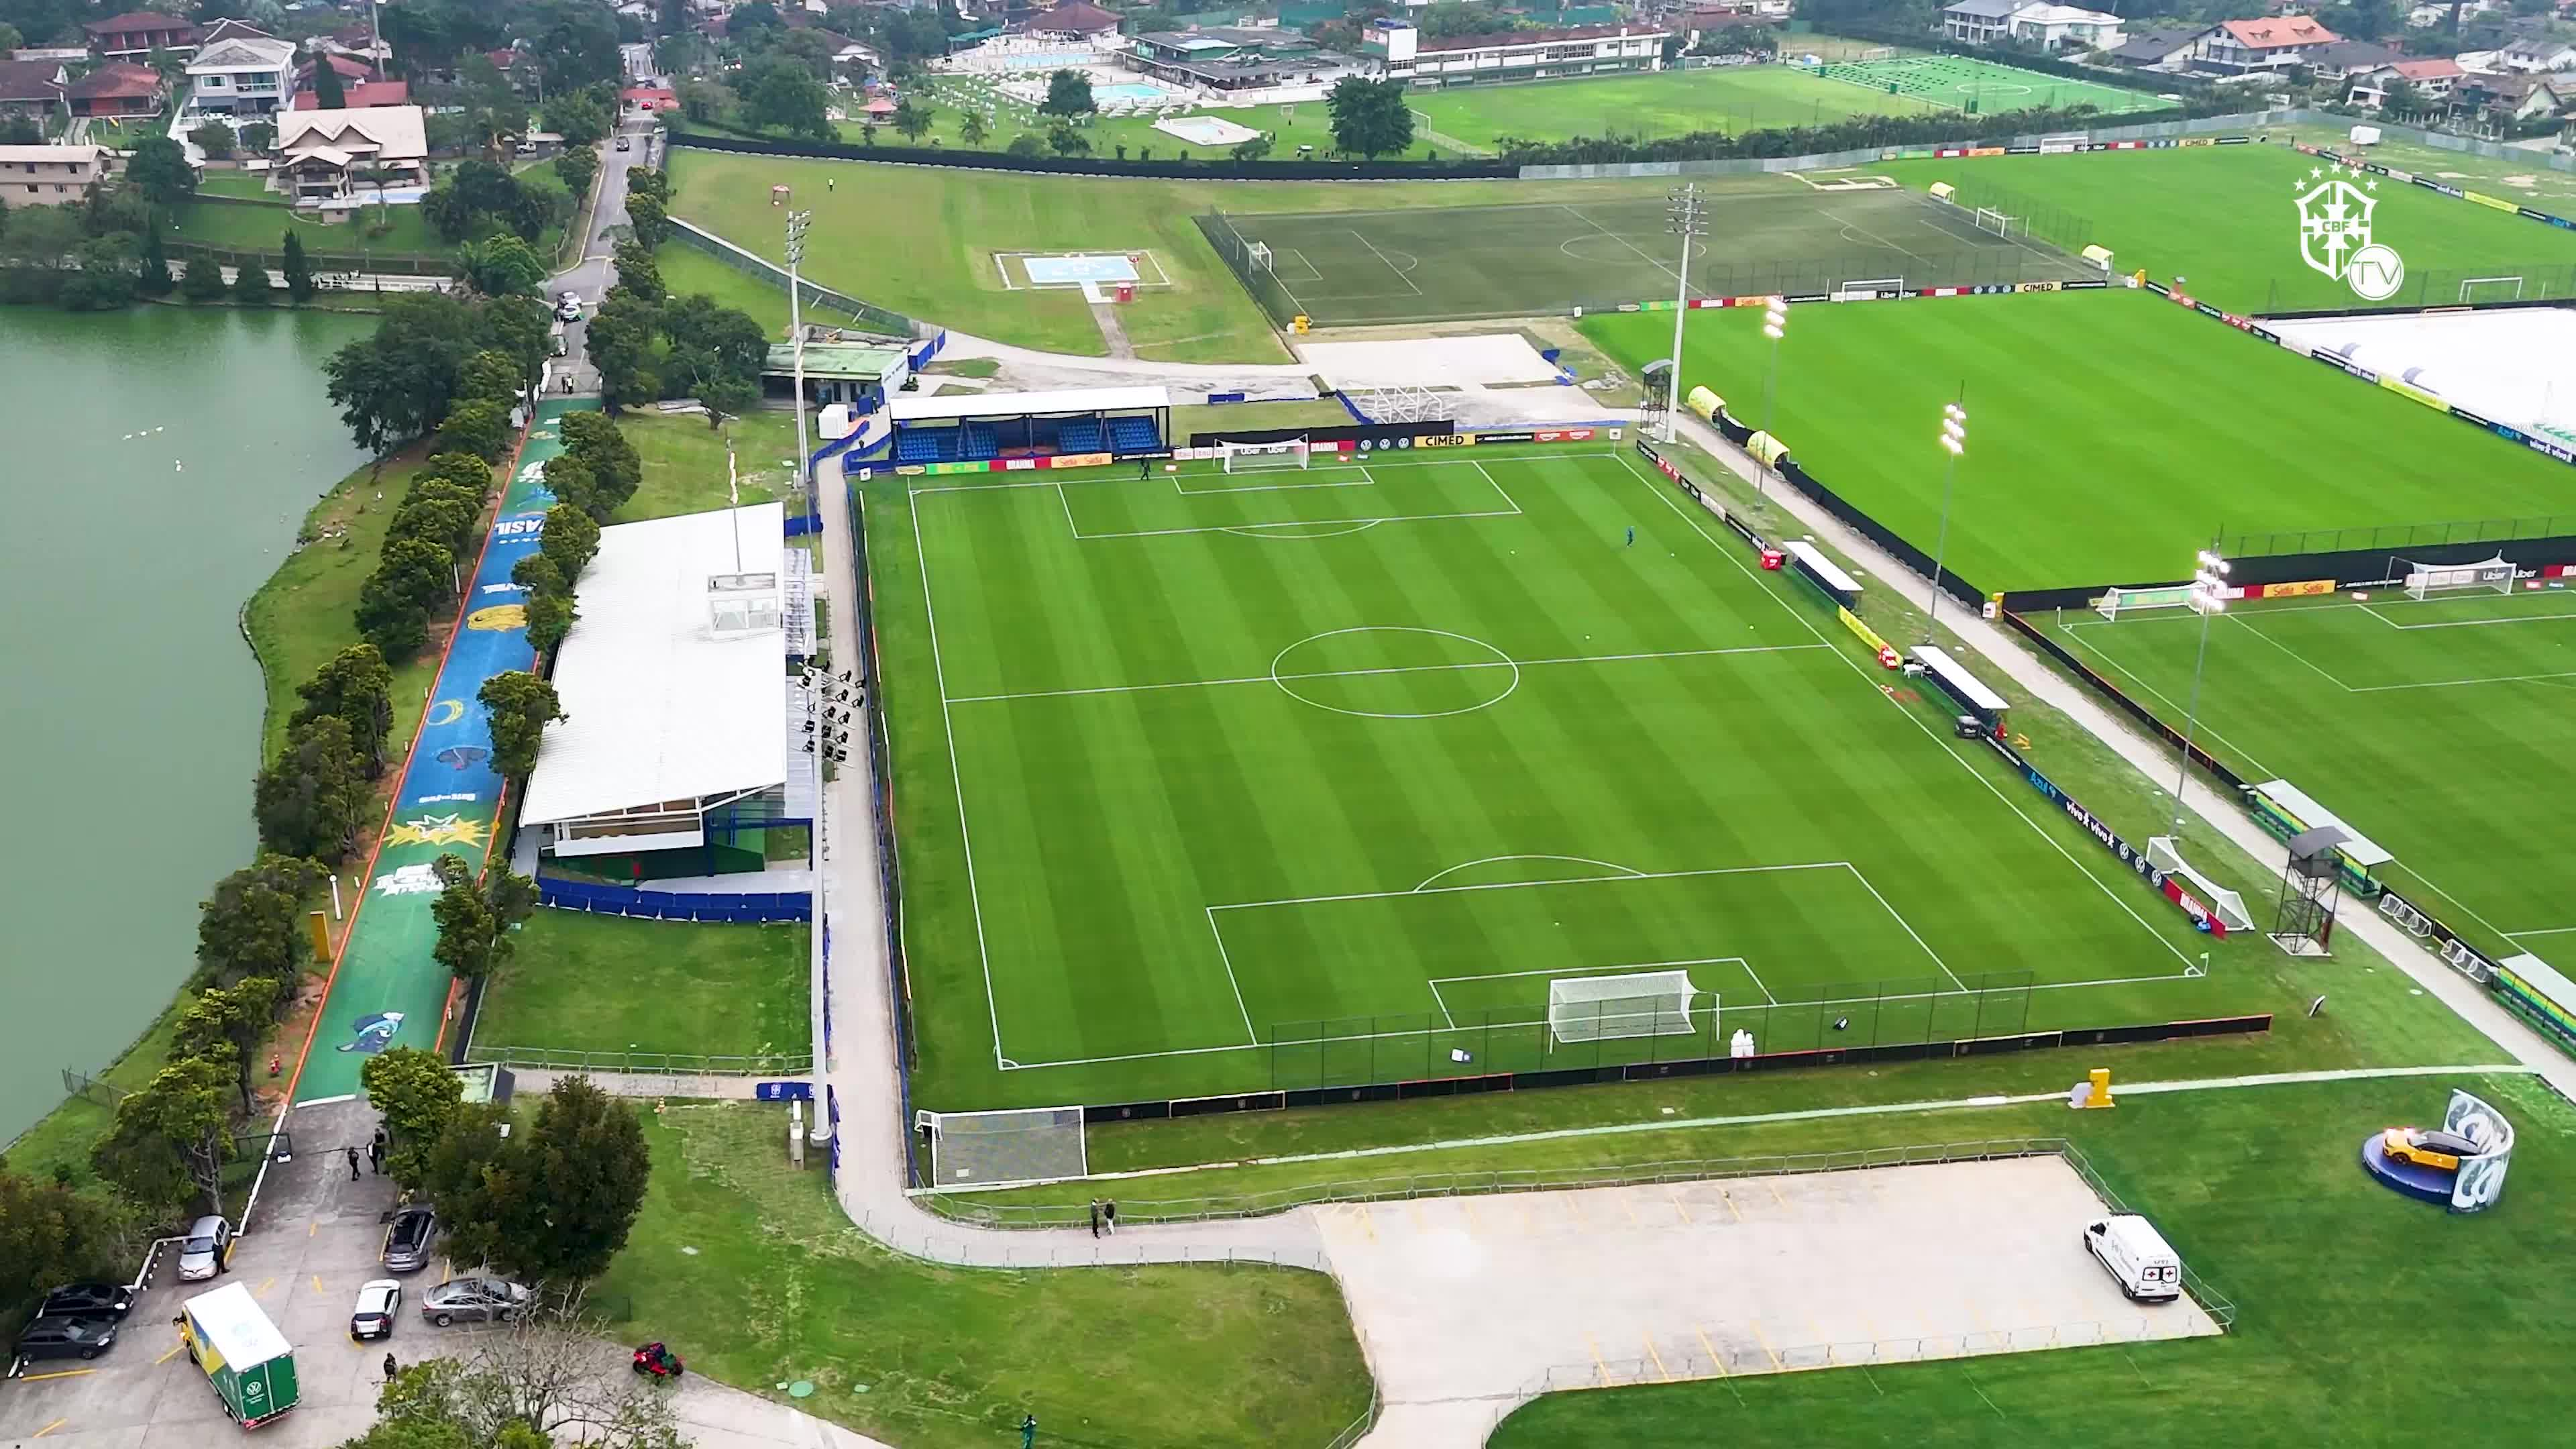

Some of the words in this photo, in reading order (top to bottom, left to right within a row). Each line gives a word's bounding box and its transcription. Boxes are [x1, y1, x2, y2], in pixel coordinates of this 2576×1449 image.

[2023, 282, 2053, 293] CIMED
[1426, 435, 1464, 446] CIMED
[2030, 771, 2048, 794] Azul
[2065, 801, 2083, 822] vivo
[2090, 821, 2108, 843] vivo
